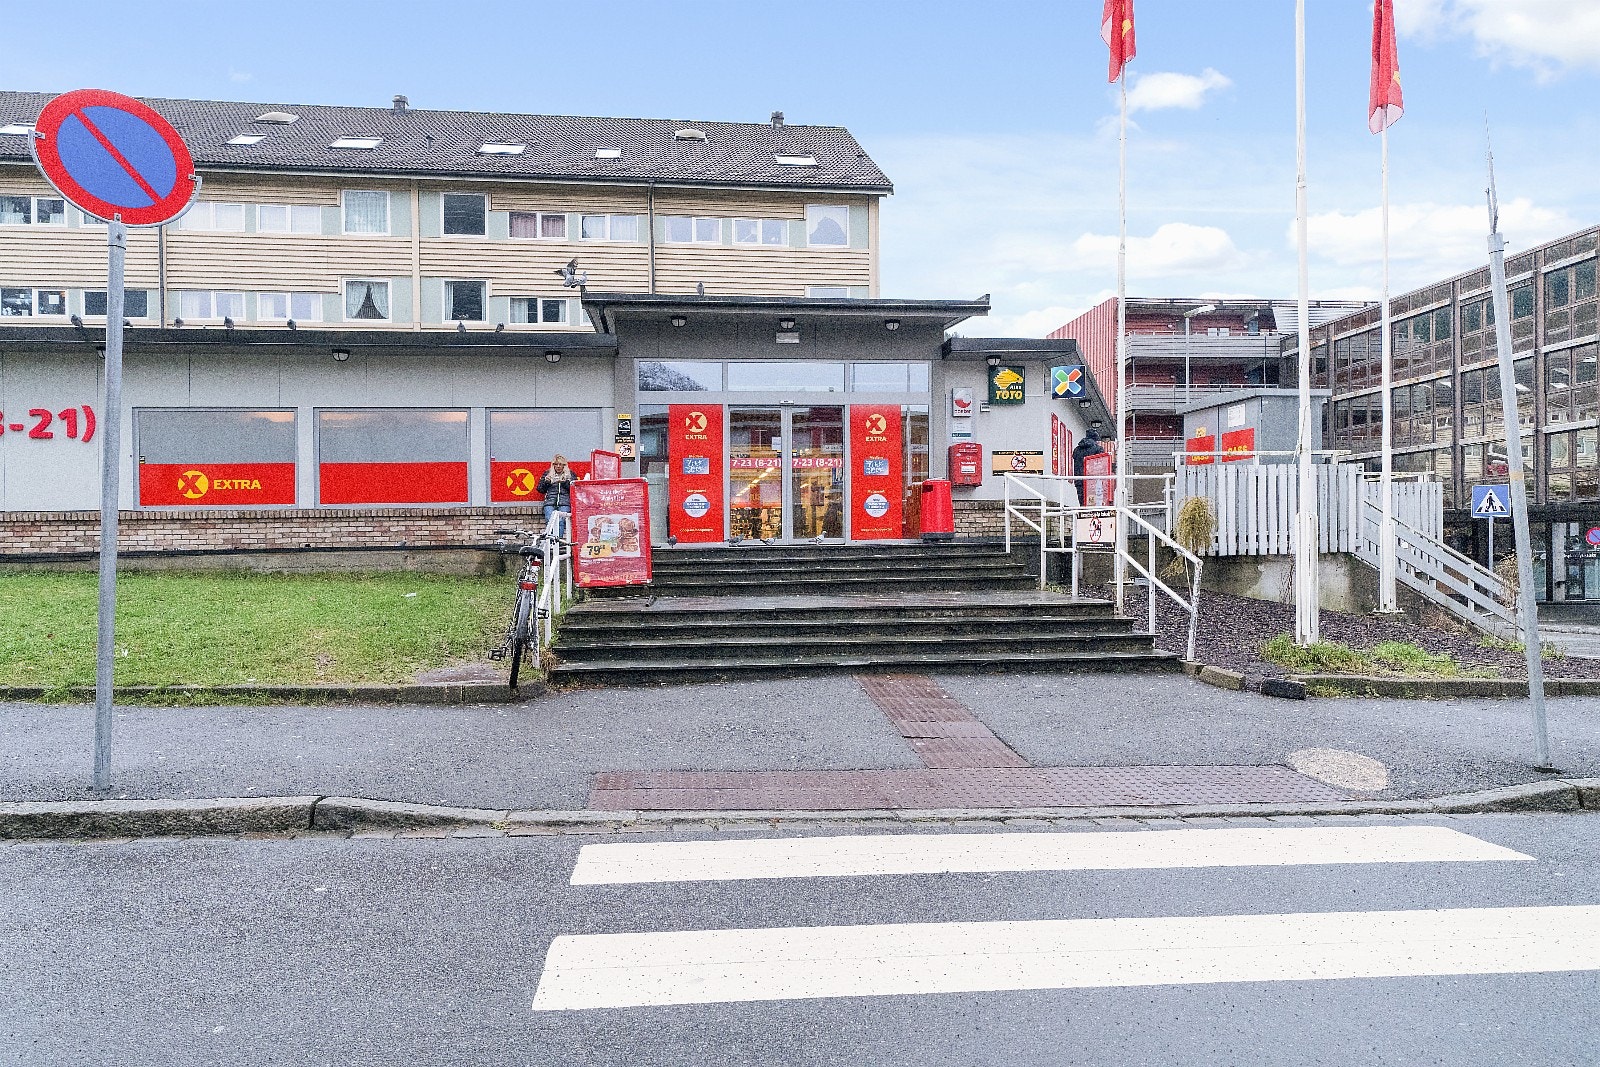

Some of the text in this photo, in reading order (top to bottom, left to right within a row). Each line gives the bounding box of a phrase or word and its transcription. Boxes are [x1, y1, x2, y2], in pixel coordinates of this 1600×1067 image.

[995, 390, 1023, 400] TOTO
[0, 404, 96, 443] -21)
[732, 458, 782, 469] 7-23 (8-21)
[793, 458, 843, 468] 7-23 (8-21)
[213, 479, 262, 490] EXTRA
